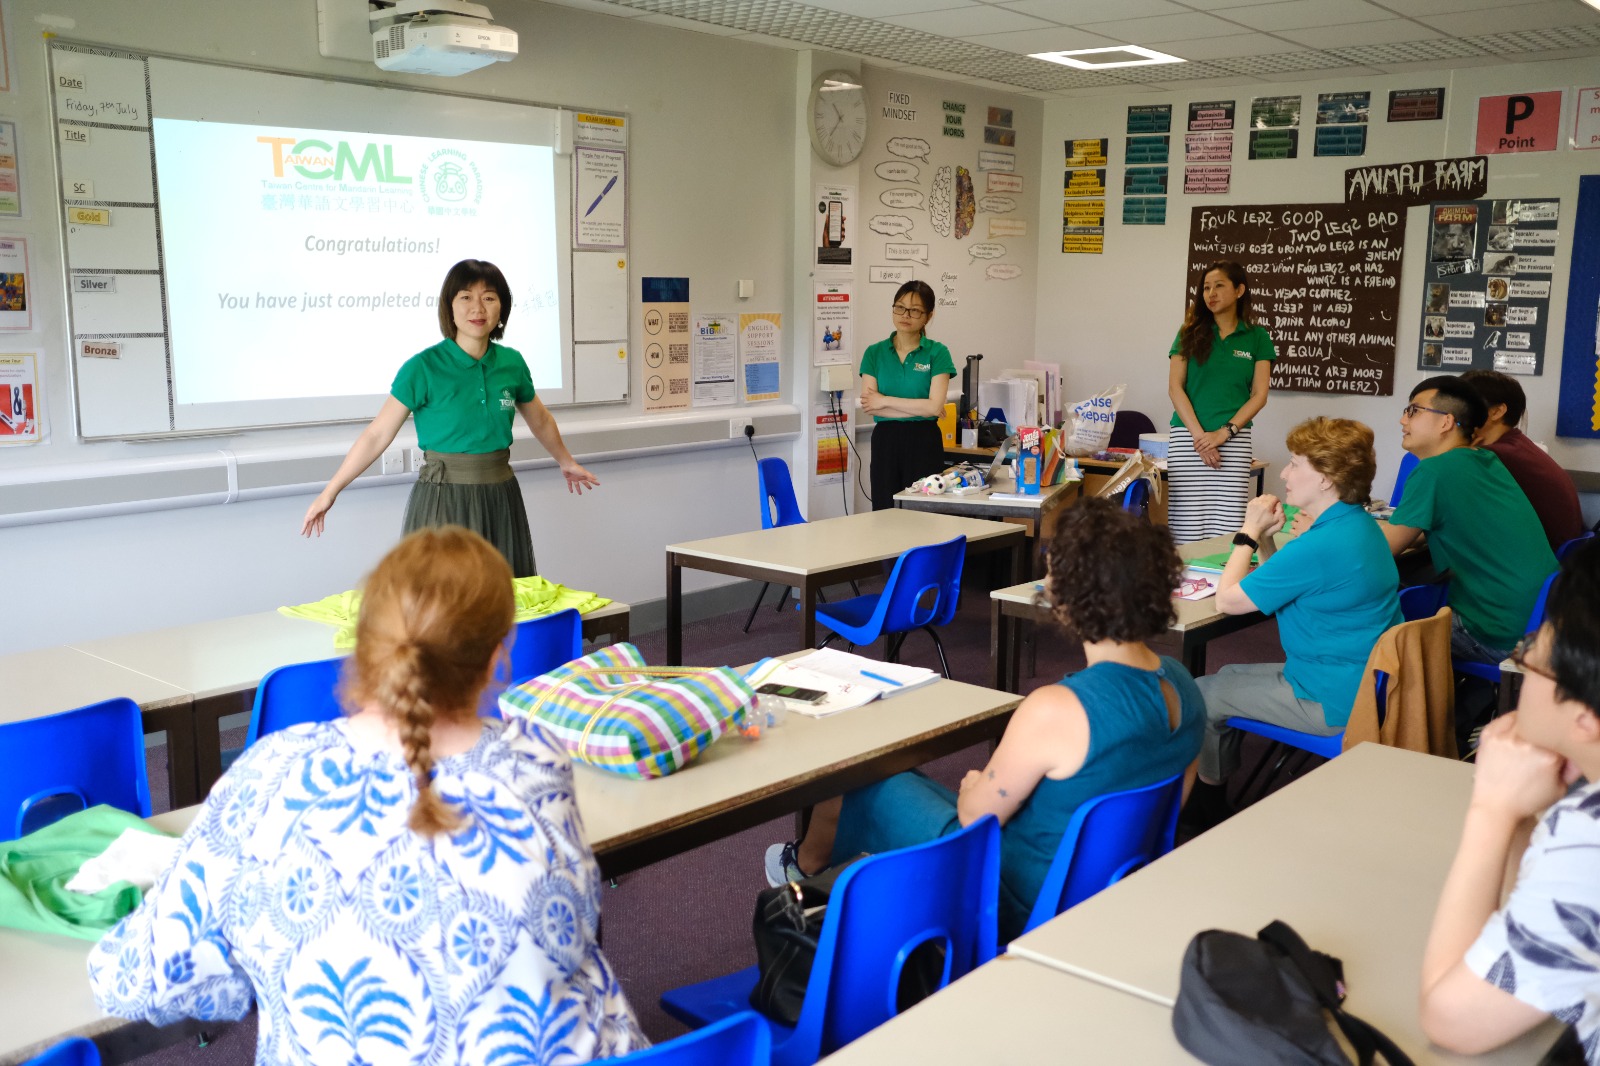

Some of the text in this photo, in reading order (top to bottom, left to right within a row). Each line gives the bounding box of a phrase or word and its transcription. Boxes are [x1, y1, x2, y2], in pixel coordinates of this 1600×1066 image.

[59, 76, 83, 89] Date
[889, 92, 910, 105] FIXED
[66, 98, 98, 117] Friday,
[116, 102, 138, 120] July
[882, 107, 917, 121] MINDSET
[942, 101, 966, 114] CHANGE
[945, 114, 962, 125] YOUR
[1197, 111, 1224, 119] Optimistic
[1506, 95, 1535, 135] P
[64, 129, 86, 142] Title
[943, 127, 965, 138] WORDS
[1499, 136, 1535, 149] Point
[256, 136, 413, 184] TCML
[419, 148, 483, 205] CHINESE LEARNING PARADISE
[1435, 158, 1486, 192] FARM
[73, 181, 86, 194] SC
[261, 179, 413, 196] Taiwan Centre for Mandarin Learning
[77, 211, 101, 222] Gold
[1200, 209, 1238, 232] FOUR
[1438, 213, 1473, 222] FARM
[1288, 211, 1399, 245] TWO LEGS BAD
[304, 234, 441, 256] Congratulations!
[888, 247, 898, 255] This
[1193, 237, 1389, 255] WHATEVER GOES UPON TWO LEGS IS AN
[1365, 246, 1402, 262] ENEMY
[882, 270, 894, 280] give
[1246, 262, 1385, 276] GOES UPON FOUR LEGS OR HAS
[940, 271, 958, 282] Change
[1306, 274, 1337, 288] WINGS
[1341, 275, 1351, 286] IS
[1354, 276, 1362, 287] A
[80, 279, 108, 290] Silver
[1273, 287, 1307, 299] WEAR
[217, 292, 250, 309] You
[255, 292, 297, 309] have
[300, 292, 333, 312] just
[337, 291, 421, 312] completed
[938, 297, 958, 307] Mindset
[1272, 302, 1304, 313] SLEEP
[1274, 315, 1305, 329] DRINK
[747, 339, 775, 347] SESSIONS
[1275, 329, 1396, 348] KILL ANY OTHER ANIMAL
[84, 344, 118, 357] Bronze
[1272, 362, 1384, 380] ANIMALS ARE MORE
[1294, 377, 1321, 388] THAN
